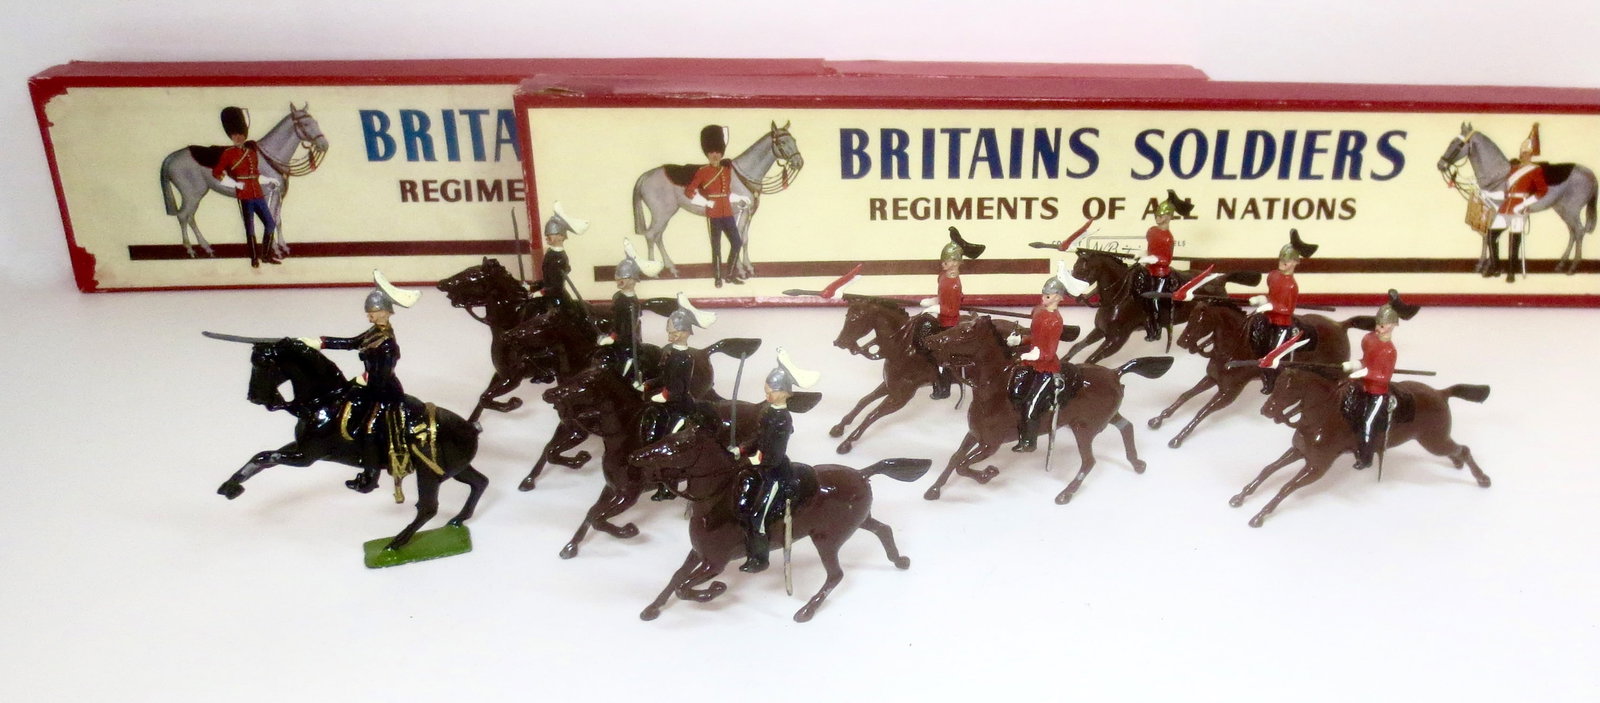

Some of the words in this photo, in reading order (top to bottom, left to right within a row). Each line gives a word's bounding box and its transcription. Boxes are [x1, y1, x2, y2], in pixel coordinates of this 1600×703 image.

[840, 127, 1100, 180] BRITAINS
[1130, 128, 1408, 181] SOLDIERS
[399, 179, 525, 203] REGIME
[869, 196, 1059, 221] REGIMENTS
[1082, 196, 1126, 220] OF
[1216, 196, 1357, 221] NATIONS
